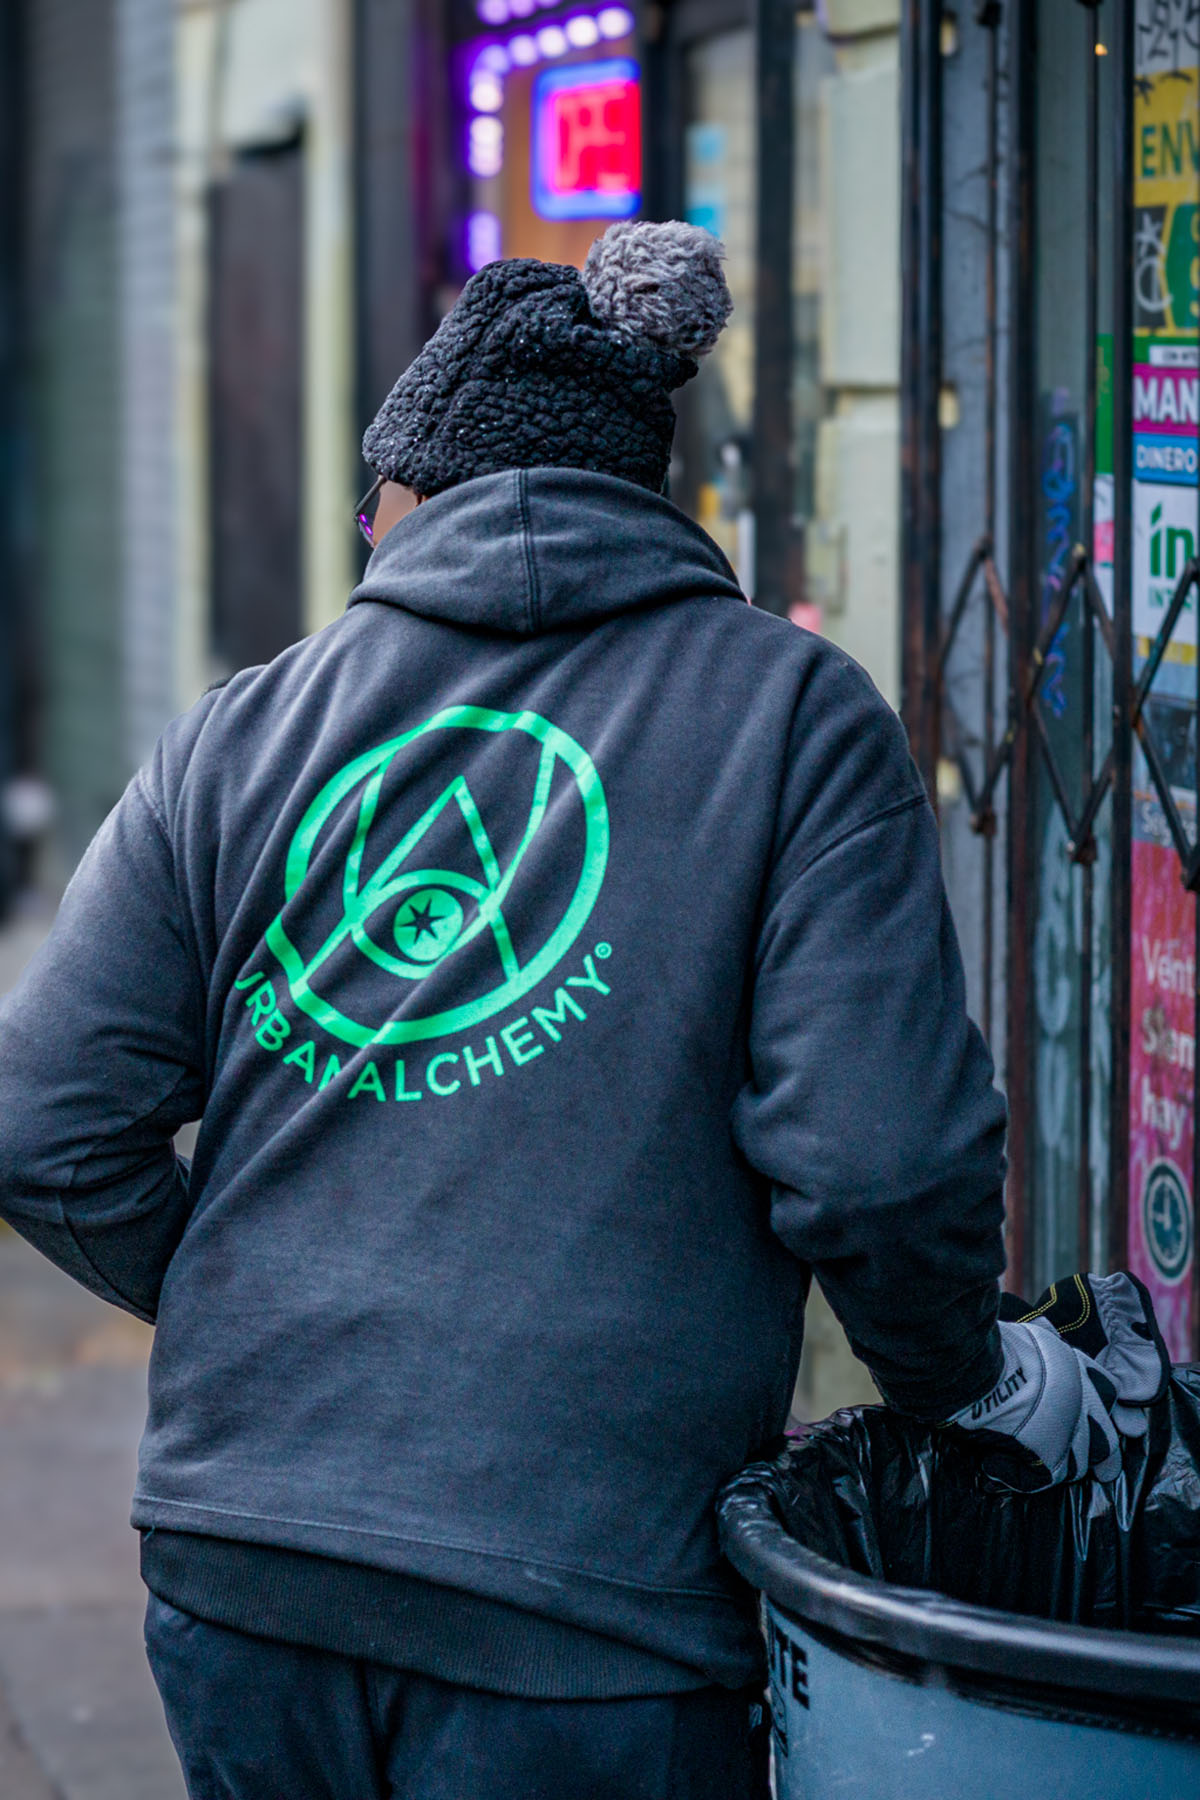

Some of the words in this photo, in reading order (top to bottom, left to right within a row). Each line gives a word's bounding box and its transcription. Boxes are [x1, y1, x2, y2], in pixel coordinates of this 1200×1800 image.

[1134, 375, 1198, 425] MAN
[1136, 444, 1198, 473] DINERO
[971, 1366, 1028, 1420] UTILITY
